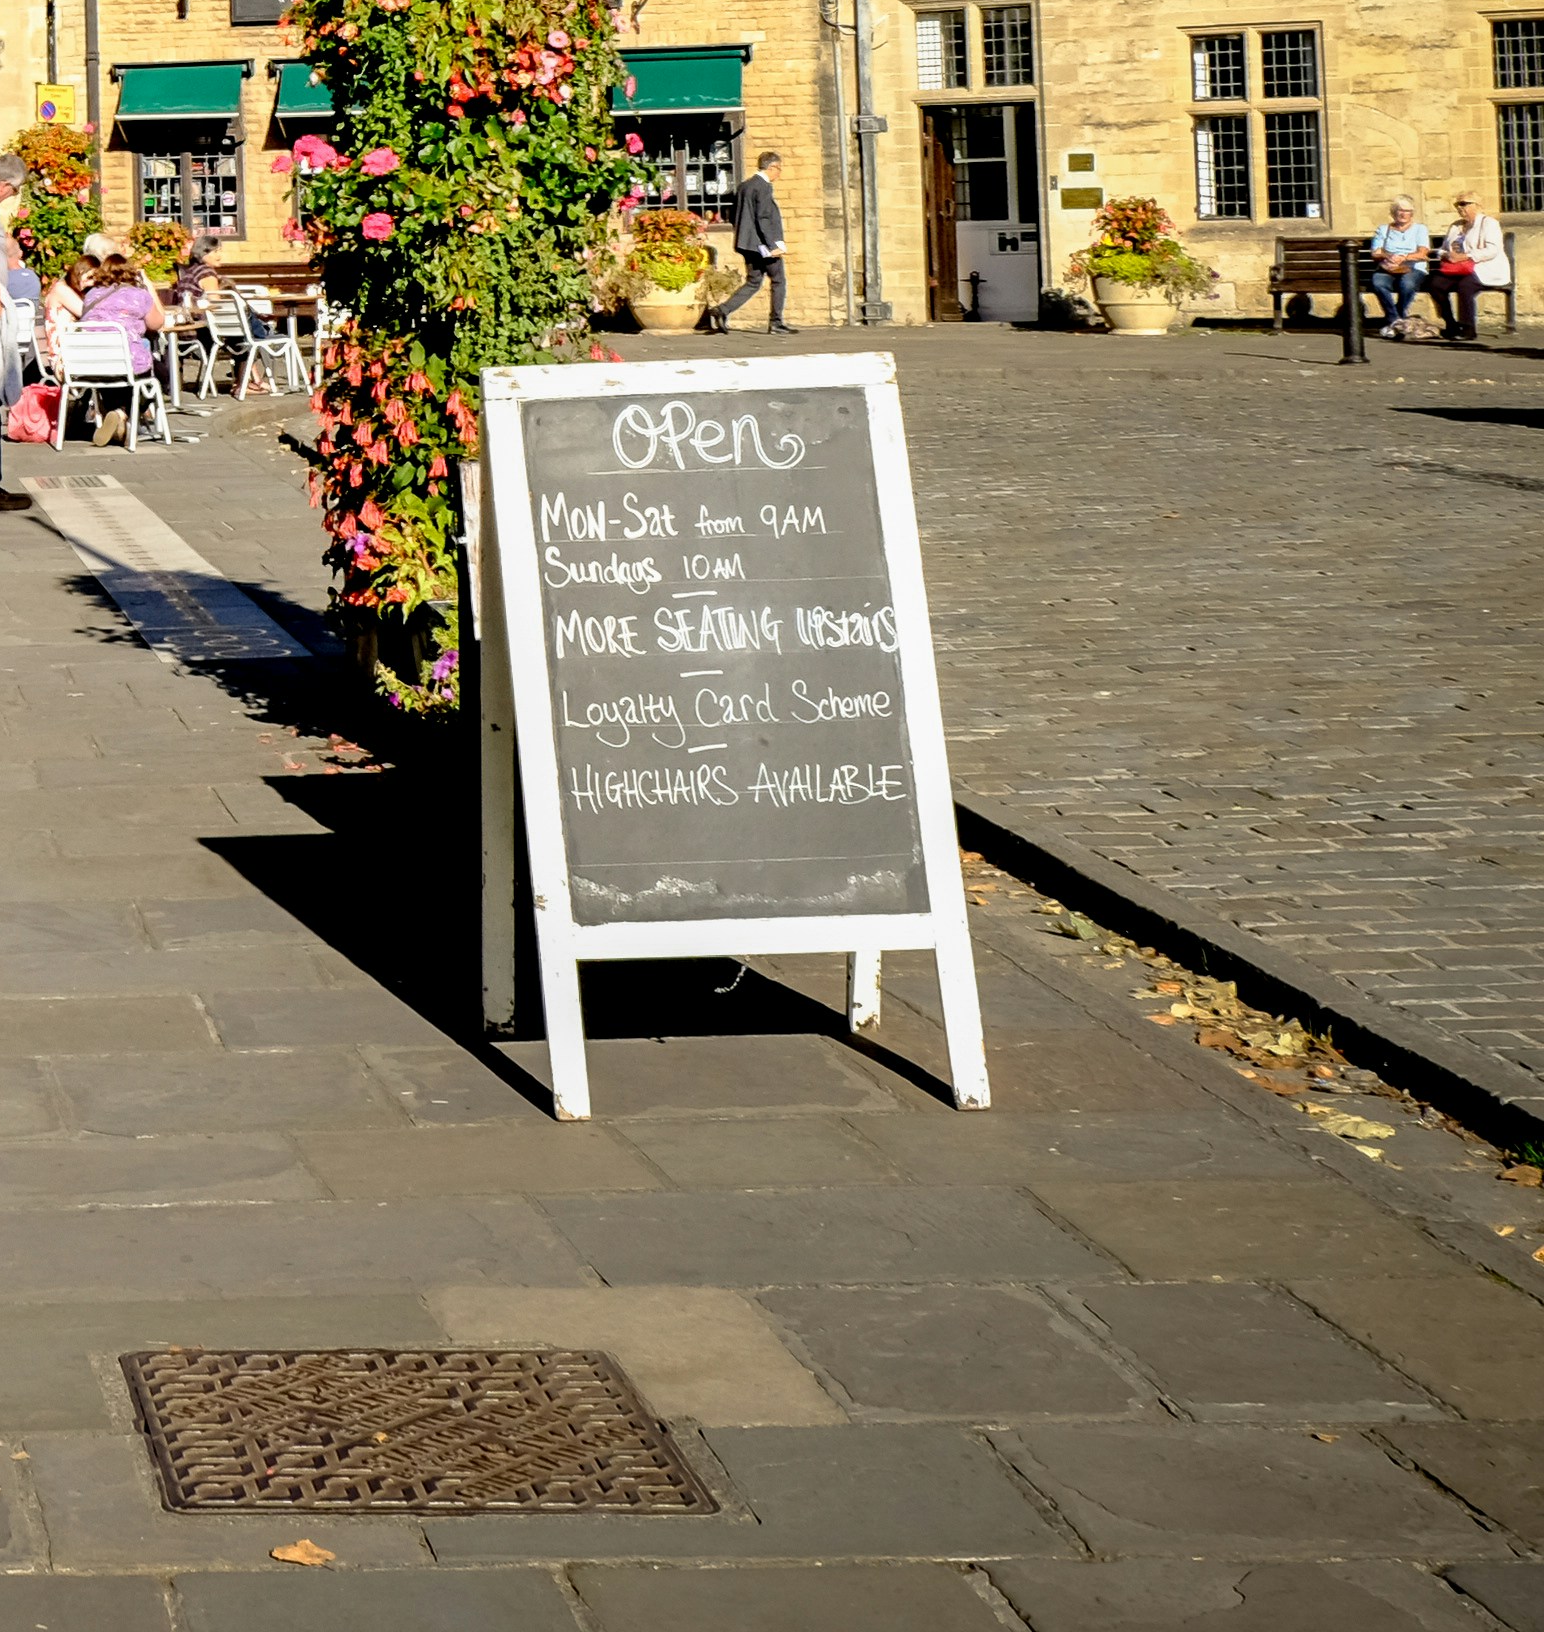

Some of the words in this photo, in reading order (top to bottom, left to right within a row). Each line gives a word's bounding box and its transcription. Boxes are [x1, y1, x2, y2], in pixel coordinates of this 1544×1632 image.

[695, 509, 746, 537] from
[759, 503, 828, 541] 9AM
[543, 547, 663, 594] Sundays
[682, 553, 746, 582] 10AM
[556, 608, 648, 659] MORE
[656, 605, 785, 655] SEATING
[562, 688, 686, 749] Loyalty
[695, 682, 777, 728] Card
[790, 679, 893, 723] Scheme
[570, 763, 740, 814] HIGHCHAIRS
[747, 764, 909, 808] AVAILABLE
